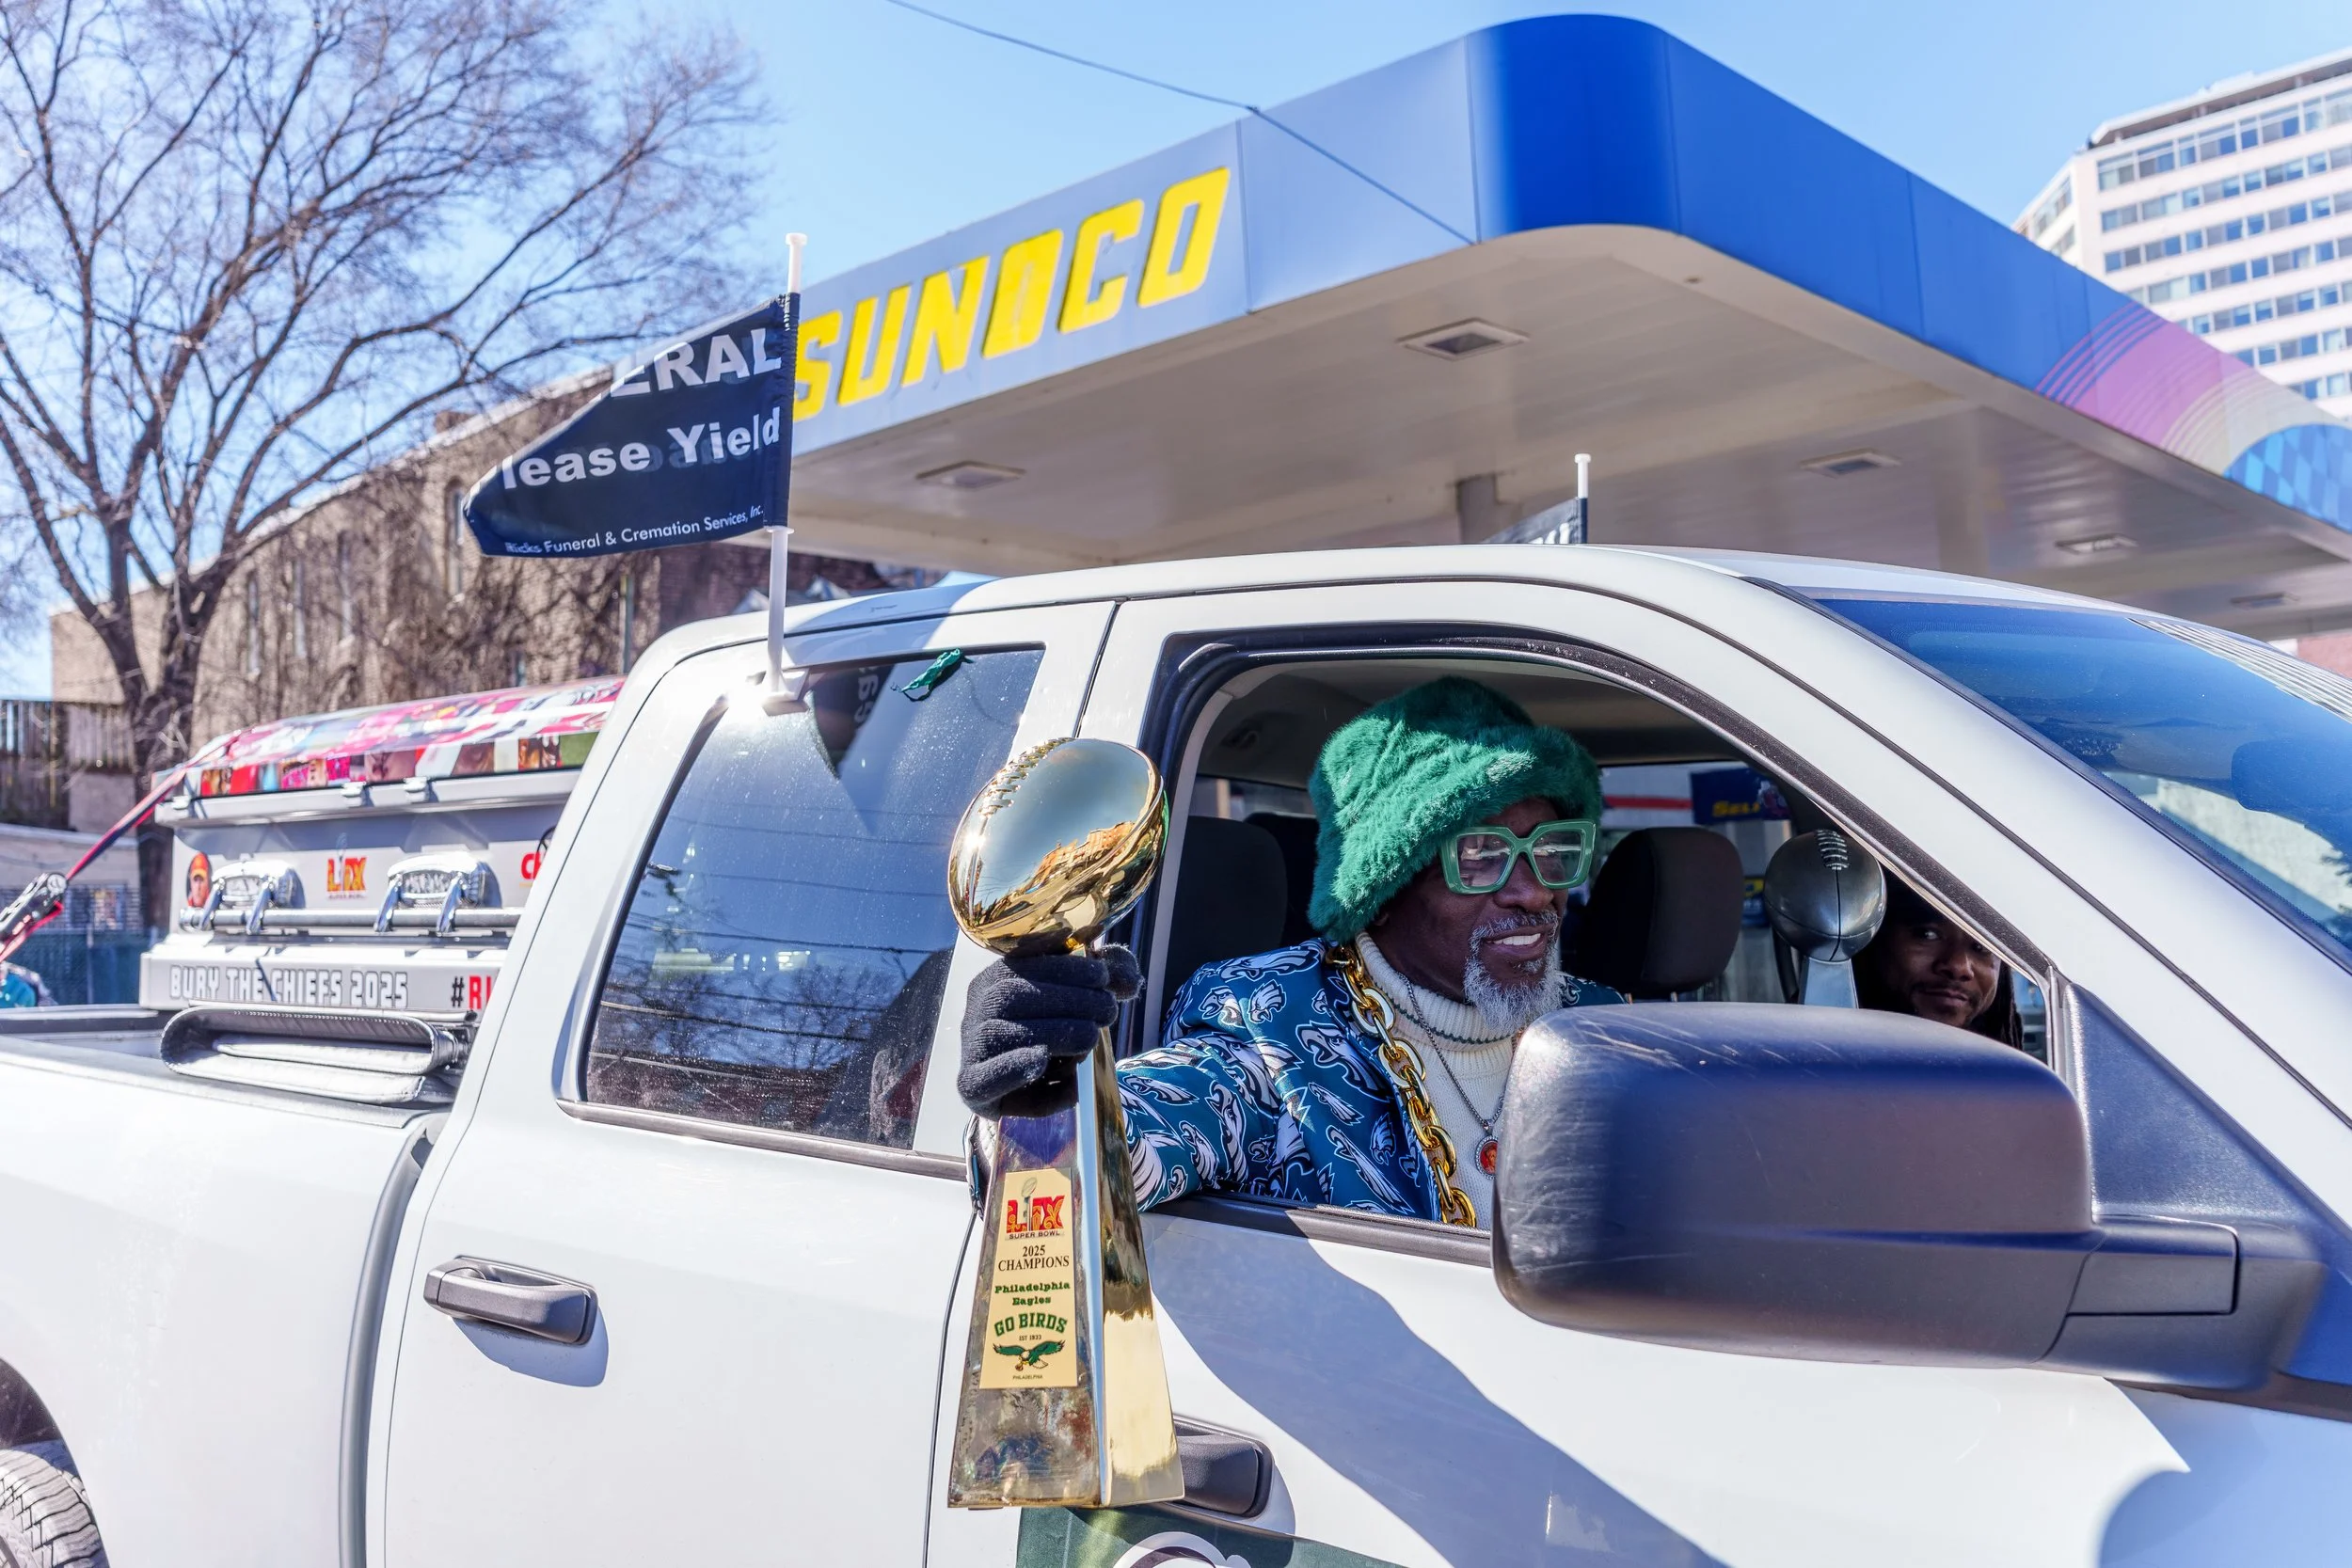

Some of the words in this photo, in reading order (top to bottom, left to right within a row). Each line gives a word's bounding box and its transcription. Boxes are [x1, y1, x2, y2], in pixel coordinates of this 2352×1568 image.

[793, 166, 1231, 422] SUNOCO
[591, 328, 782, 399] ERAL
[469, 442, 651, 493] lease
[666, 407, 780, 464] Yield
[544, 533, 600, 552] Funeral
[605, 531, 616, 545] &
[621, 519, 700, 542] Cremation
[170, 965, 220, 1000] BURY
[226, 967, 264, 1001] THE
[270, 968, 342, 1006] CHIEFS
[350, 970, 408, 1009] 2025
[998, 1256, 1070, 1272] CHAMPIONS
[1022, 1244, 1046, 1257] 2025
[994, 1281, 1070, 1293] Philadelphia
[1012, 1296, 1051, 1306] Eagles
[993, 1316, 1015, 1337] GO
[1018, 1312, 1068, 1334] BIRDS
